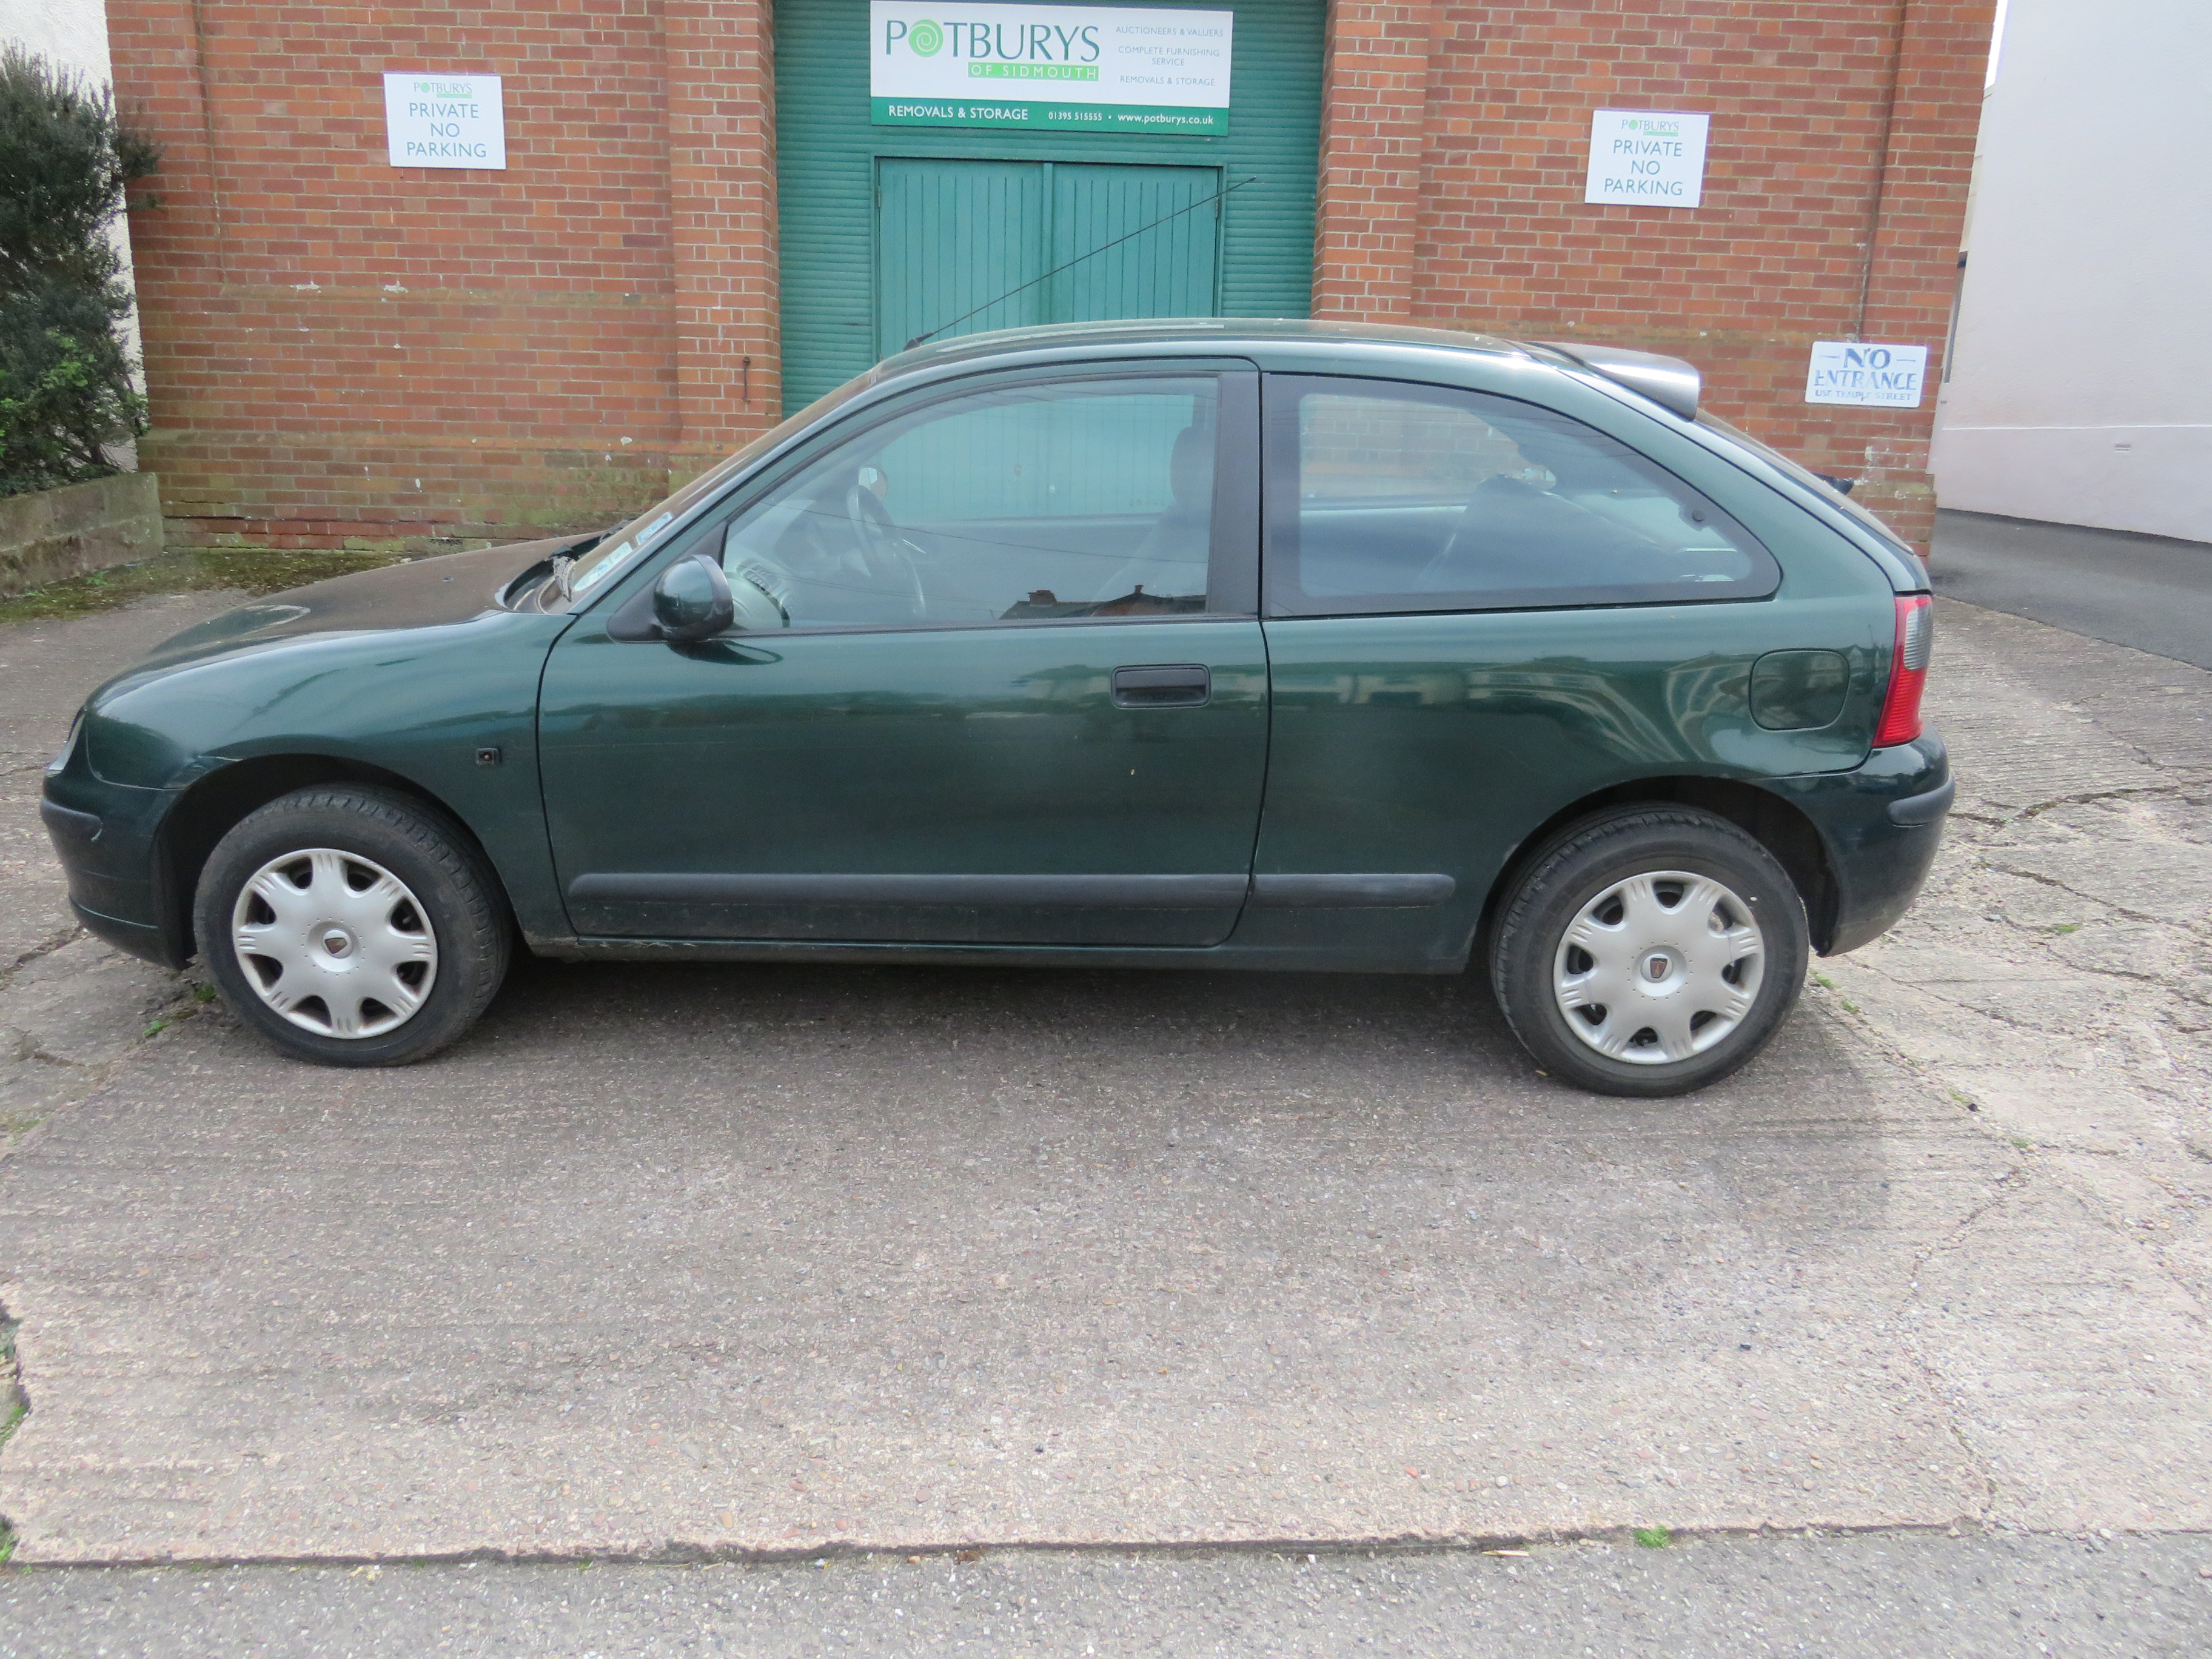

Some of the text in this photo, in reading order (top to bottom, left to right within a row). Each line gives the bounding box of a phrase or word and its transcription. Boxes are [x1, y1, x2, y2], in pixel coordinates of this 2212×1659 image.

[1115, 26, 1177, 36] AUCTIONEERS
[1187, 28, 1224, 37] VALUERS
[886, 19, 1100, 62] POTBURYS
[1118, 46, 1220, 57] COMPLETE FURNISHING
[1151, 58, 1185, 66] SERVICE
[971, 64, 1097, 80] OF SIDMOUTH
[414, 82, 472, 94] POTBURYS
[1120, 75, 1164, 85] REMOVALS
[1175, 76, 1215, 86] STORAGE
[409, 102, 479, 119] PRIVATE
[888, 104, 1028, 120] REMOVALS & STORAGE
[1048, 111, 1214, 126] 01395 515555 www.potburys.co.uk
[430, 122, 460, 138] NO
[1621, 119, 1679, 132] POTBURYS
[406, 142, 487, 158] PARKING
[1613, 139, 1683, 157] PRIVATE
[1631, 159, 1661, 175] NO
[1604, 178, 1683, 196] PARKING
[1843, 347, 1892, 370] NO
[1814, 369, 1917, 390] ENTRANCE
